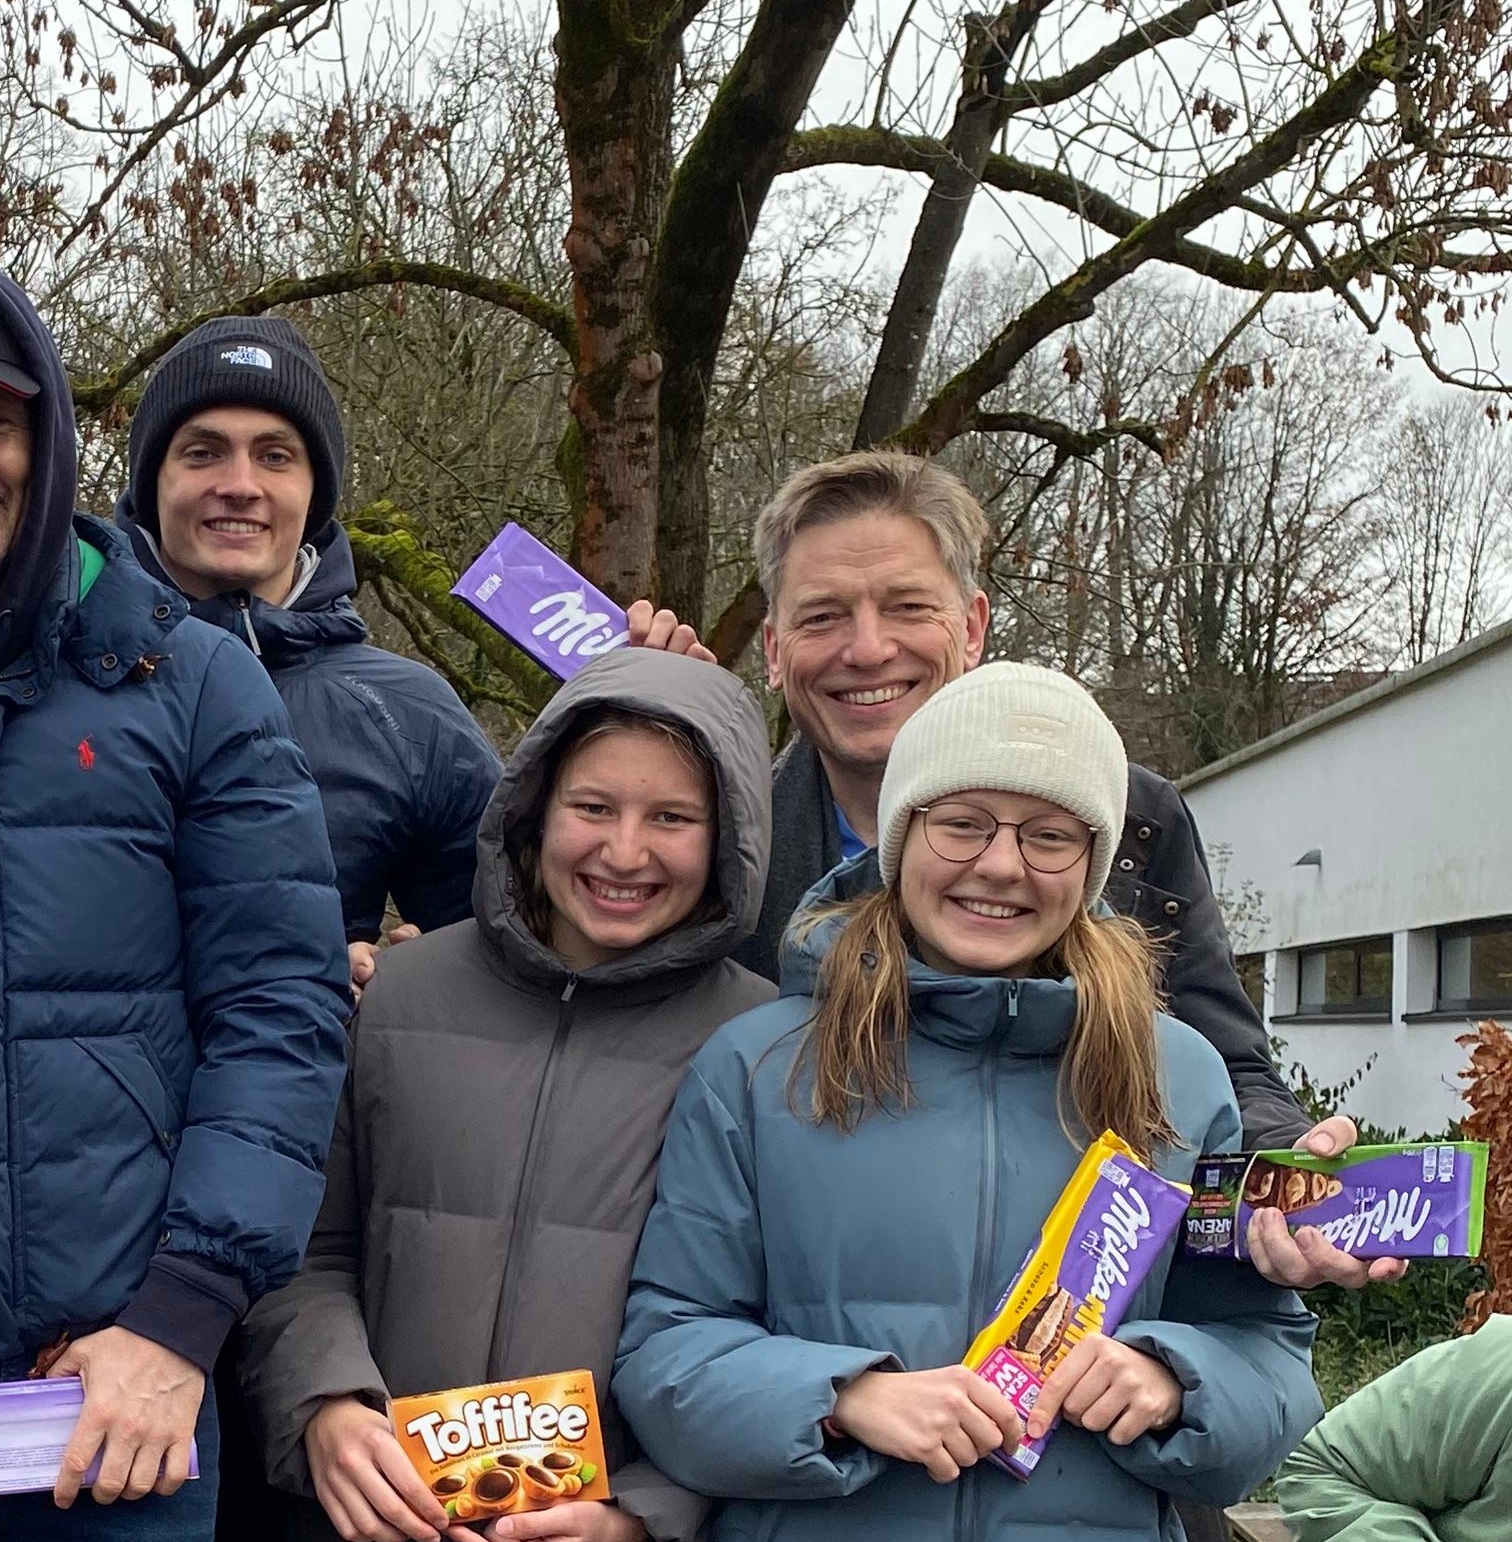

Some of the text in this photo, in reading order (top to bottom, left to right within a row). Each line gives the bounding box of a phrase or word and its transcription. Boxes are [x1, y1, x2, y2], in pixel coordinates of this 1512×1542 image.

[529, 590, 631, 656] Mil
[1091, 1187, 1151, 1302] Milka
[1187, 1217, 1232, 1234] ARENA
[1318, 1185, 1431, 1253] Milka
[406, 1391, 588, 1463] Toffifee
